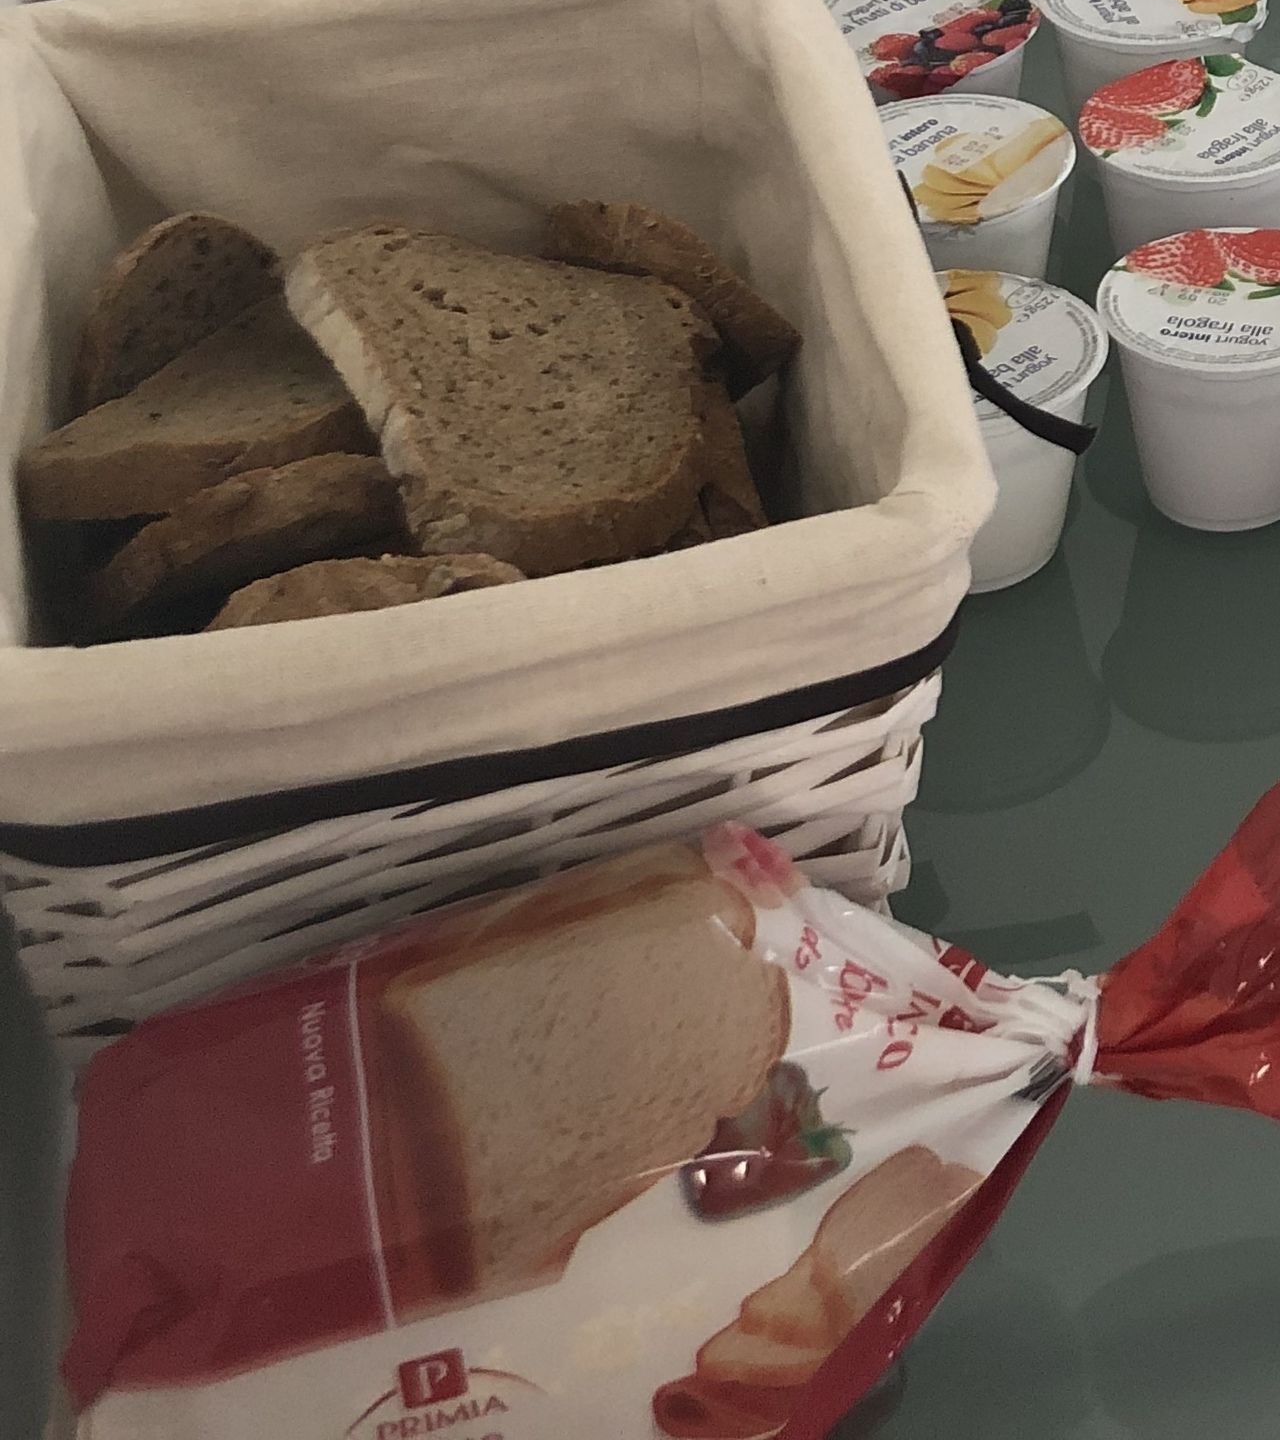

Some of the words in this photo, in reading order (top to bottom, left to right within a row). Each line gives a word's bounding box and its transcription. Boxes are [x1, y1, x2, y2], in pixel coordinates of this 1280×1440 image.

[851, 8, 890, 27] frutti
[901, 118, 939, 142] intero
[1242, 118, 1269, 137] alla
[903, 125, 958, 157] banana
[1196, 130, 1246, 160] fragola
[1159, 328, 1213, 344] intero
[1166, 315, 1236, 335] fragola
[1240, 324, 1274, 337] alla
[1215, 334, 1271, 346] yogurt
[1010, 345, 1043, 366] alla
[1012, 353, 1059, 384] yogurt
[297, 1000, 327, 1083] Nuova
[308, 1085, 337, 1164] Ricetta
[376, 1395, 510, 1440] PRIMIA
